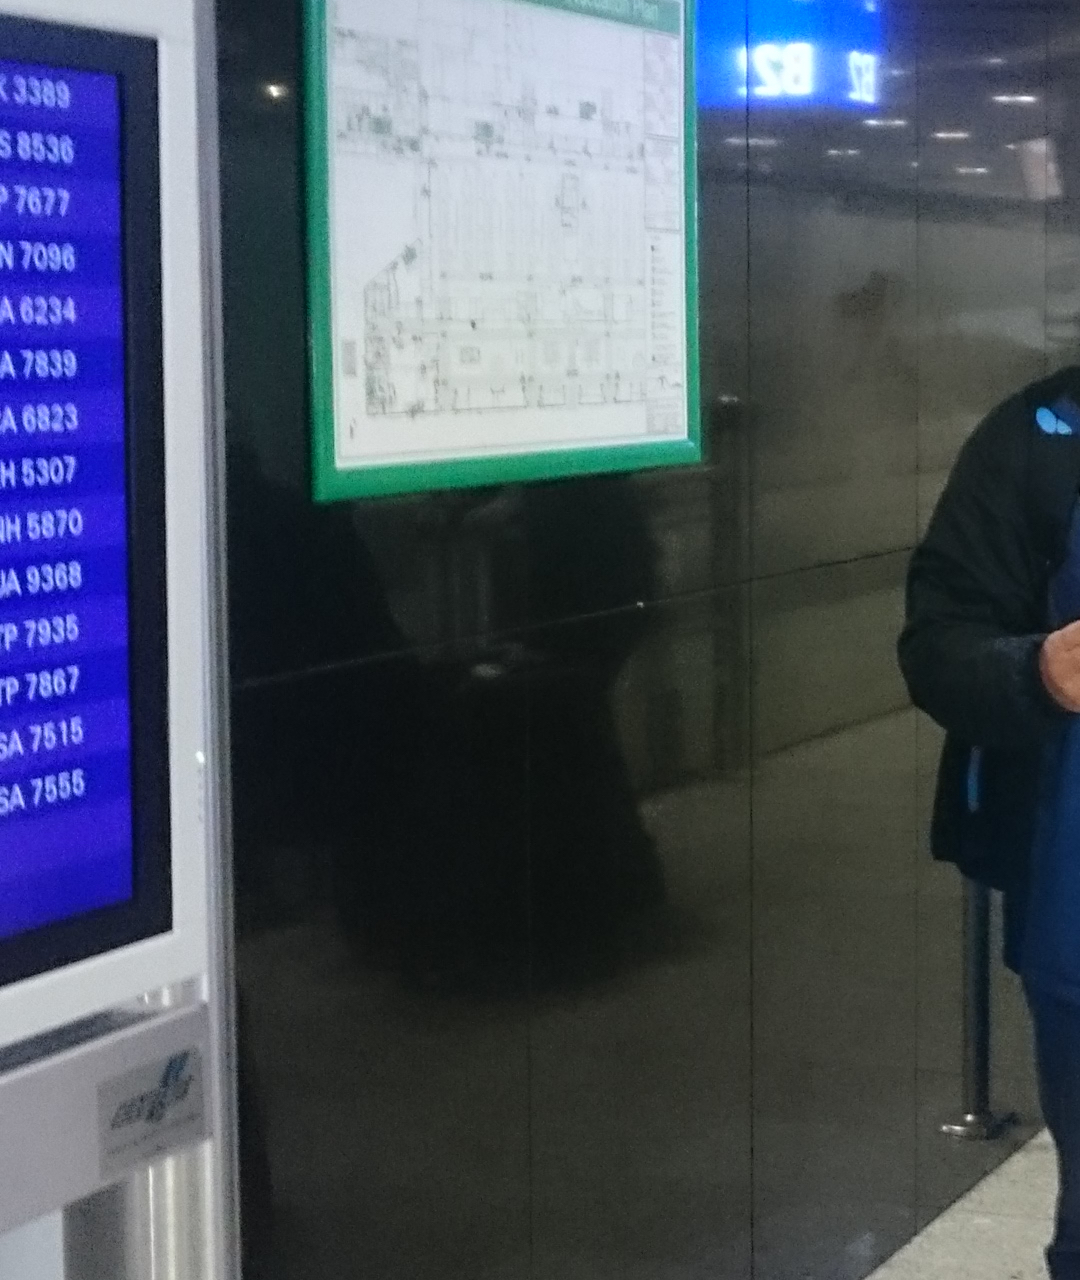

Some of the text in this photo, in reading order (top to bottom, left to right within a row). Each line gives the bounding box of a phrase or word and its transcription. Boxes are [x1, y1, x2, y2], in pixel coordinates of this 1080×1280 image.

[13, 74, 71, 109] 3389
[17, 130, 75, 164] 8536
[14, 185, 70, 217] 7677
[19, 240, 76, 272] 7096
[20, 295, 77, 326] 6234
[20, 349, 78, 379] 7839
[22, 402, 79, 434] 6823
[22, 455, 77, 487] 5307
[27, 508, 83, 540] 5870
[26, 561, 82, 595] 9368
[23, 613, 80, 648] 7935
[25, 665, 80, 701] 7867
[29, 715, 84, 754] 7515
[30, 768, 86, 808] 7555
